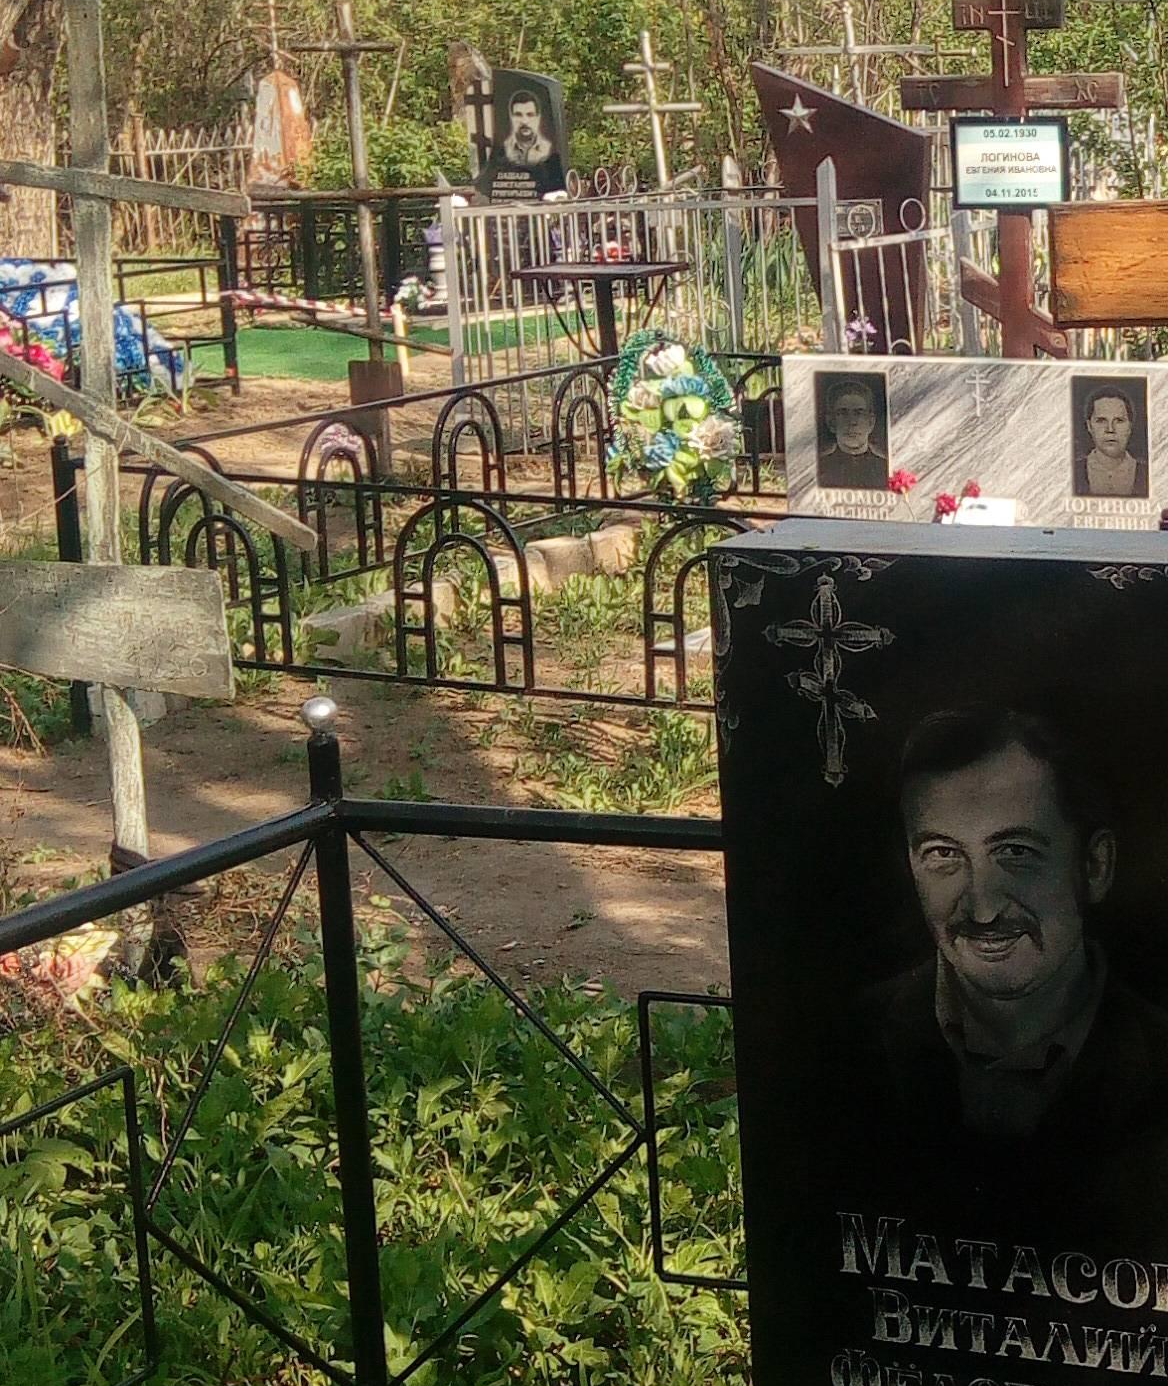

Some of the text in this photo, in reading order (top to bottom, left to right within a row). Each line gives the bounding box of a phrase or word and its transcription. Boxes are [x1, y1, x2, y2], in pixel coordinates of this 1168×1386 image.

[983, 128, 1037, 139] 05.02.1930
[980, 152, 1040, 163] ЛОГИНОВА
[965, 165, 1057, 175] ЕВГЕНИЯ ИВАНОВНА
[867, 1286, 1168, 1378] ВИТАЛИЙ
